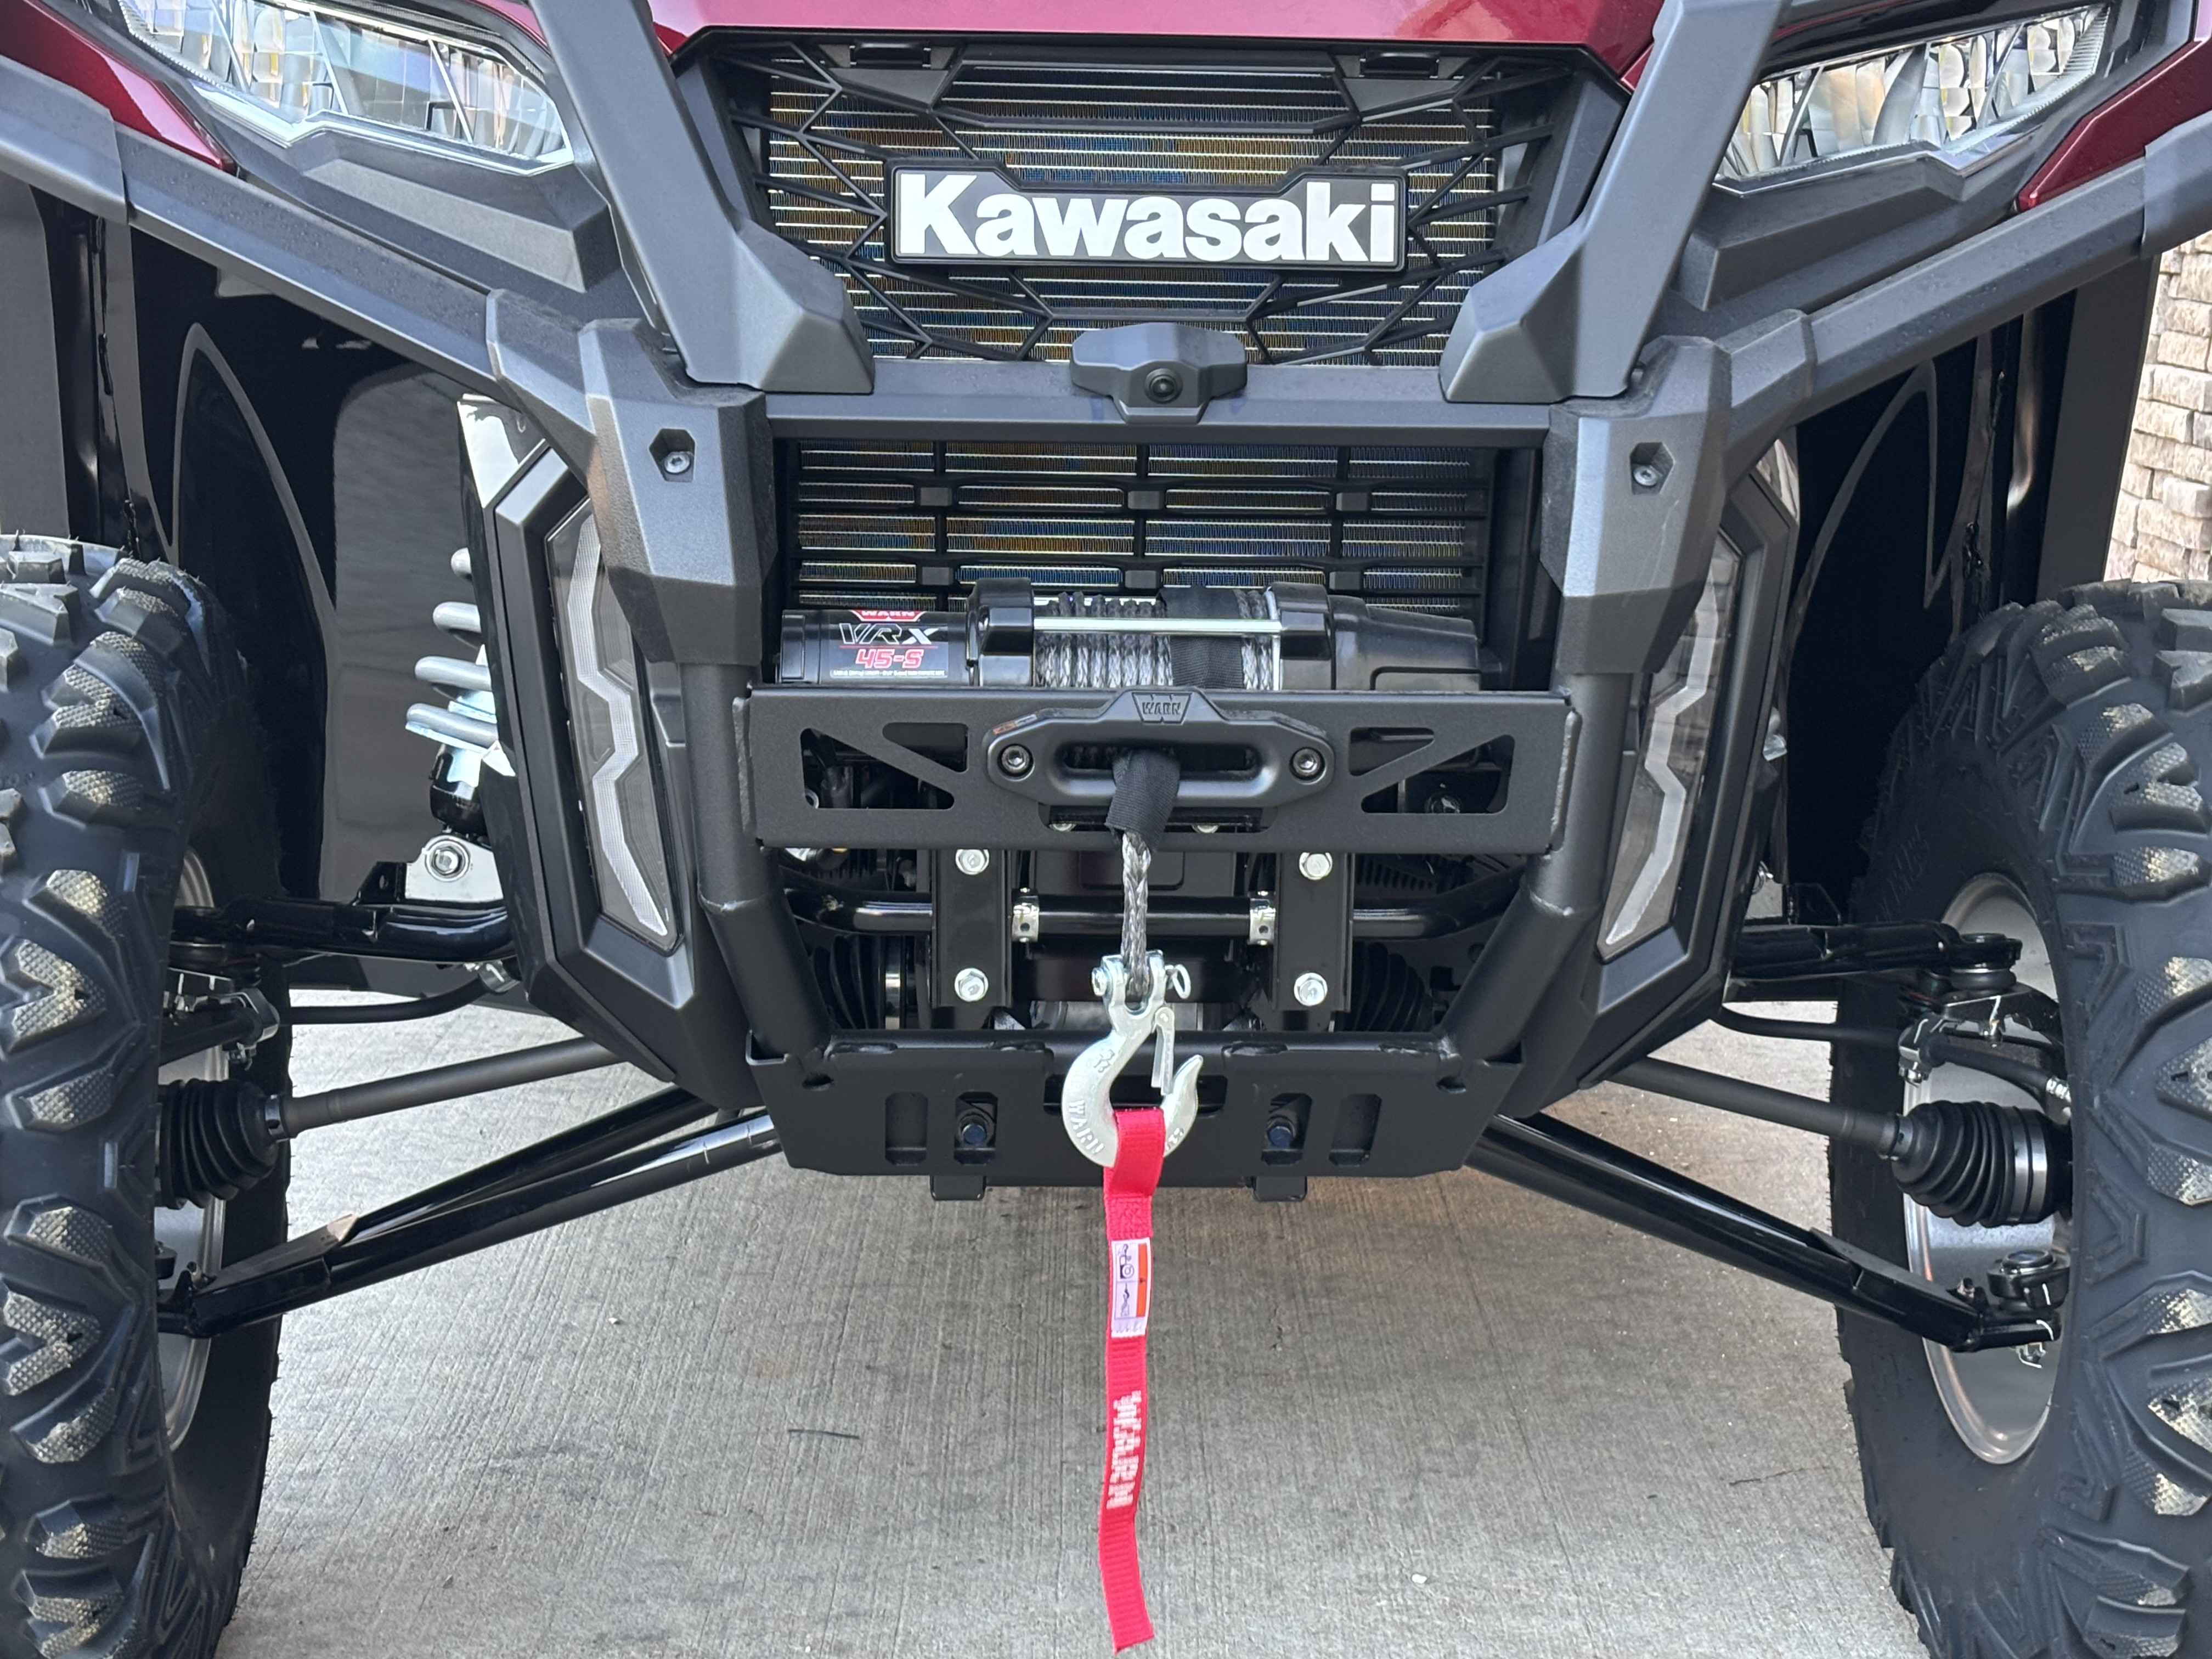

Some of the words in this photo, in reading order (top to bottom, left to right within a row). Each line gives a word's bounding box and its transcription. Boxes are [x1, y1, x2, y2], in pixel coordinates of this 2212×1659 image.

[900, 173, 1396, 263] Kawasaki
[838, 623, 939, 645] VRX
[855, 649, 924, 669] 45-S
[1142, 702, 1182, 715] WARN
[1068, 1099, 1105, 1155] WARN
[1106, 1390, 1142, 1510] WARN
